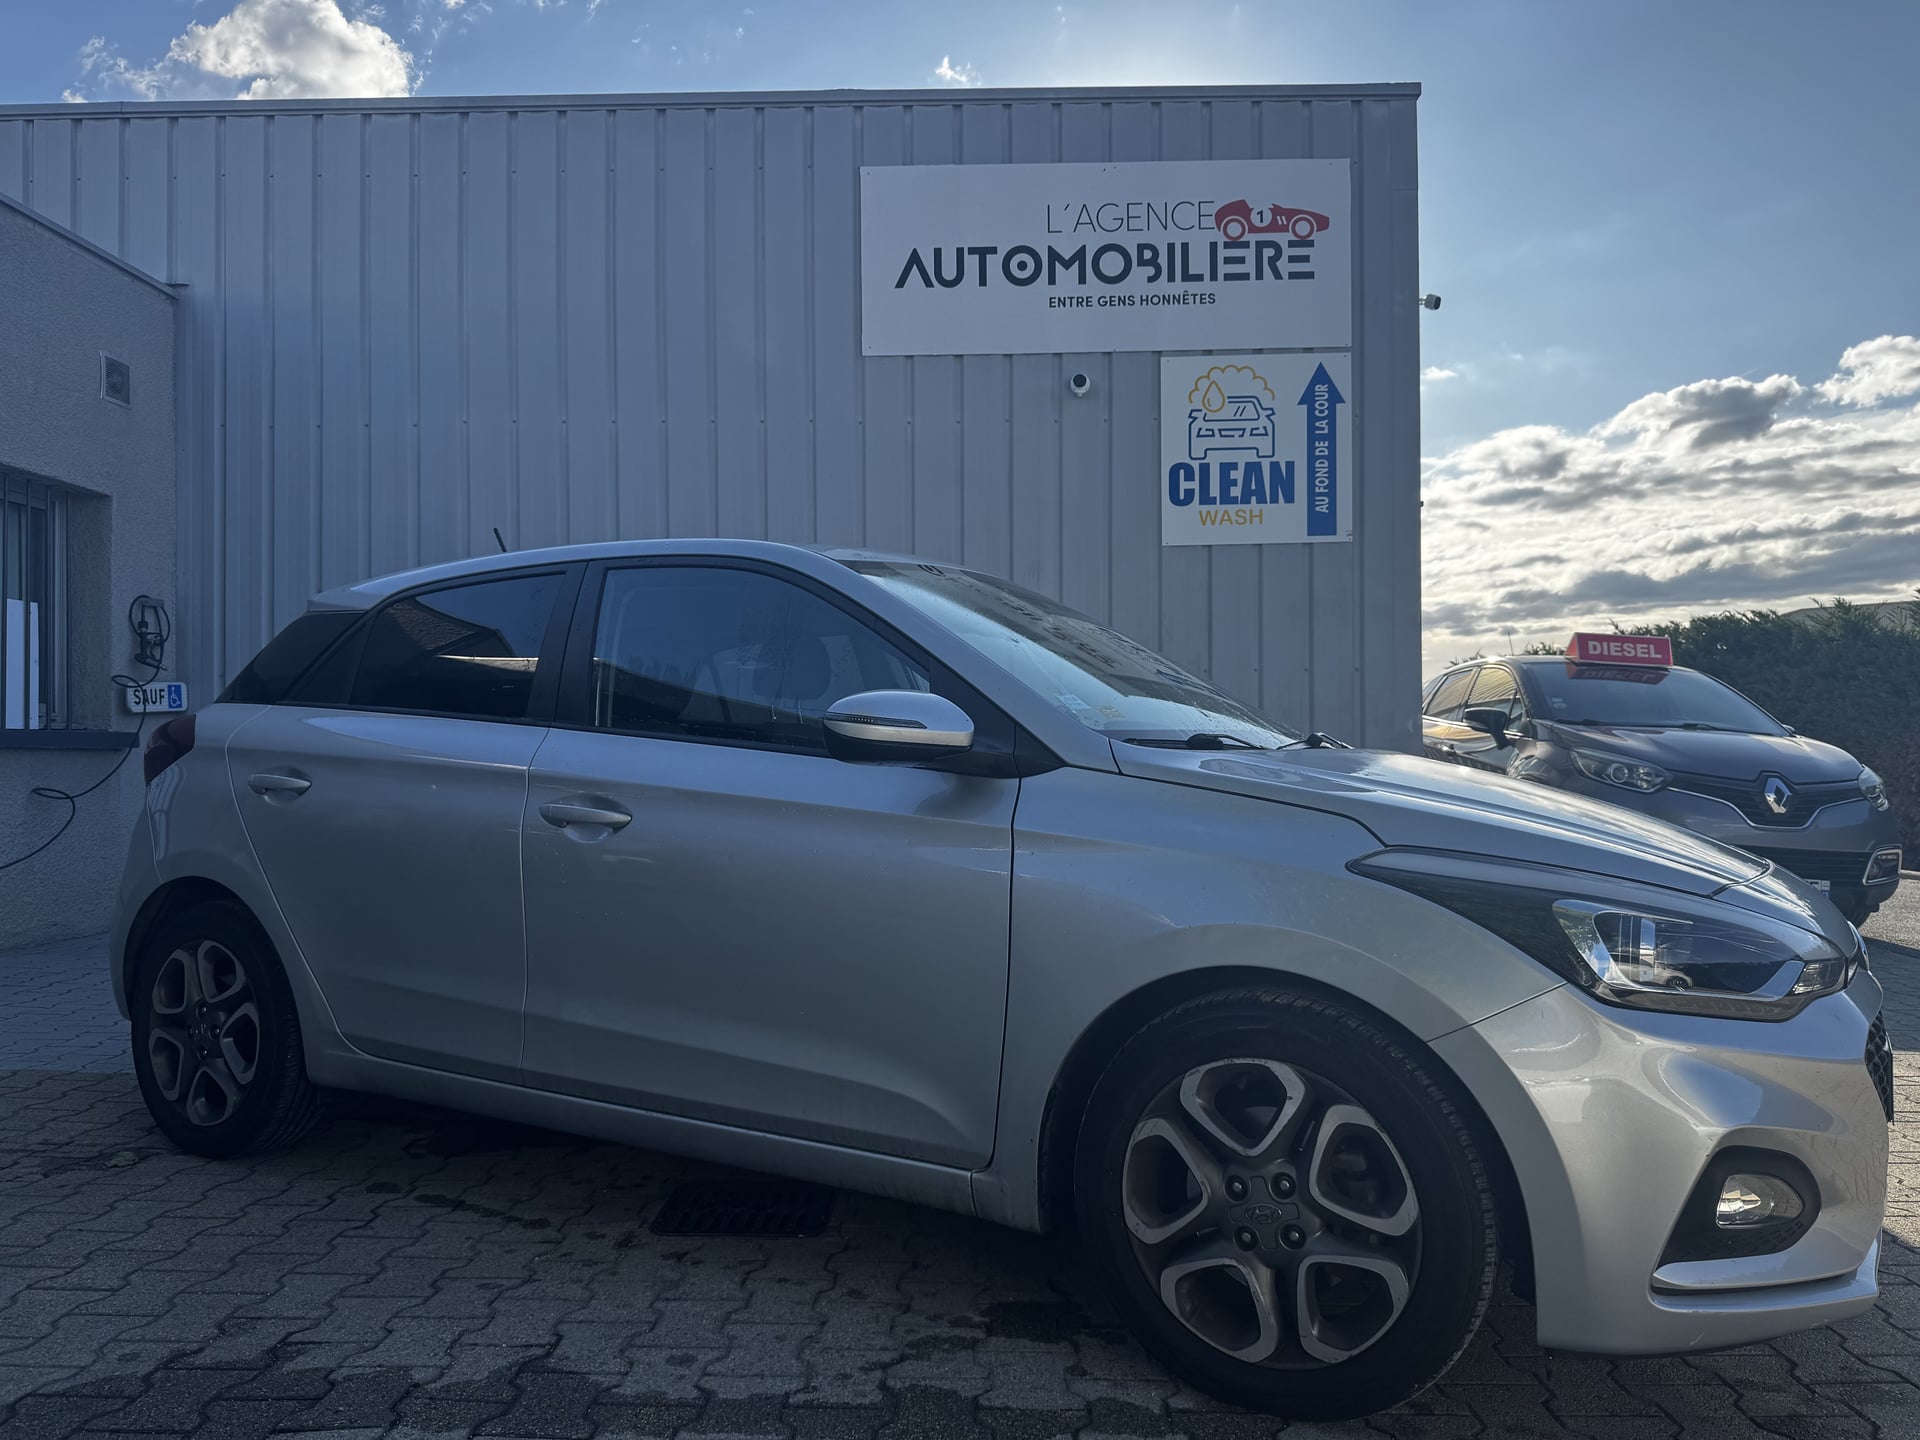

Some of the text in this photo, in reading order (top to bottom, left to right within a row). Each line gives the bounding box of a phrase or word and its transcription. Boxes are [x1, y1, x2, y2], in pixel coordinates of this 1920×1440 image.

[1047, 201, 1215, 233] L'AGENCE
[1256, 209, 1265, 224] 1
[895, 239, 1315, 288] AUTOMOBILIERE
[1049, 290, 1216, 308] ENTRE GENS HONNÊTES
[1315, 384, 1328, 513] AU FOND DE LA COUR
[1168, 461, 1295, 507] CLEAN
[1199, 508, 1263, 526] WASH
[1587, 640, 1662, 658] DIESEL
[133, 688, 165, 705] SAUF
